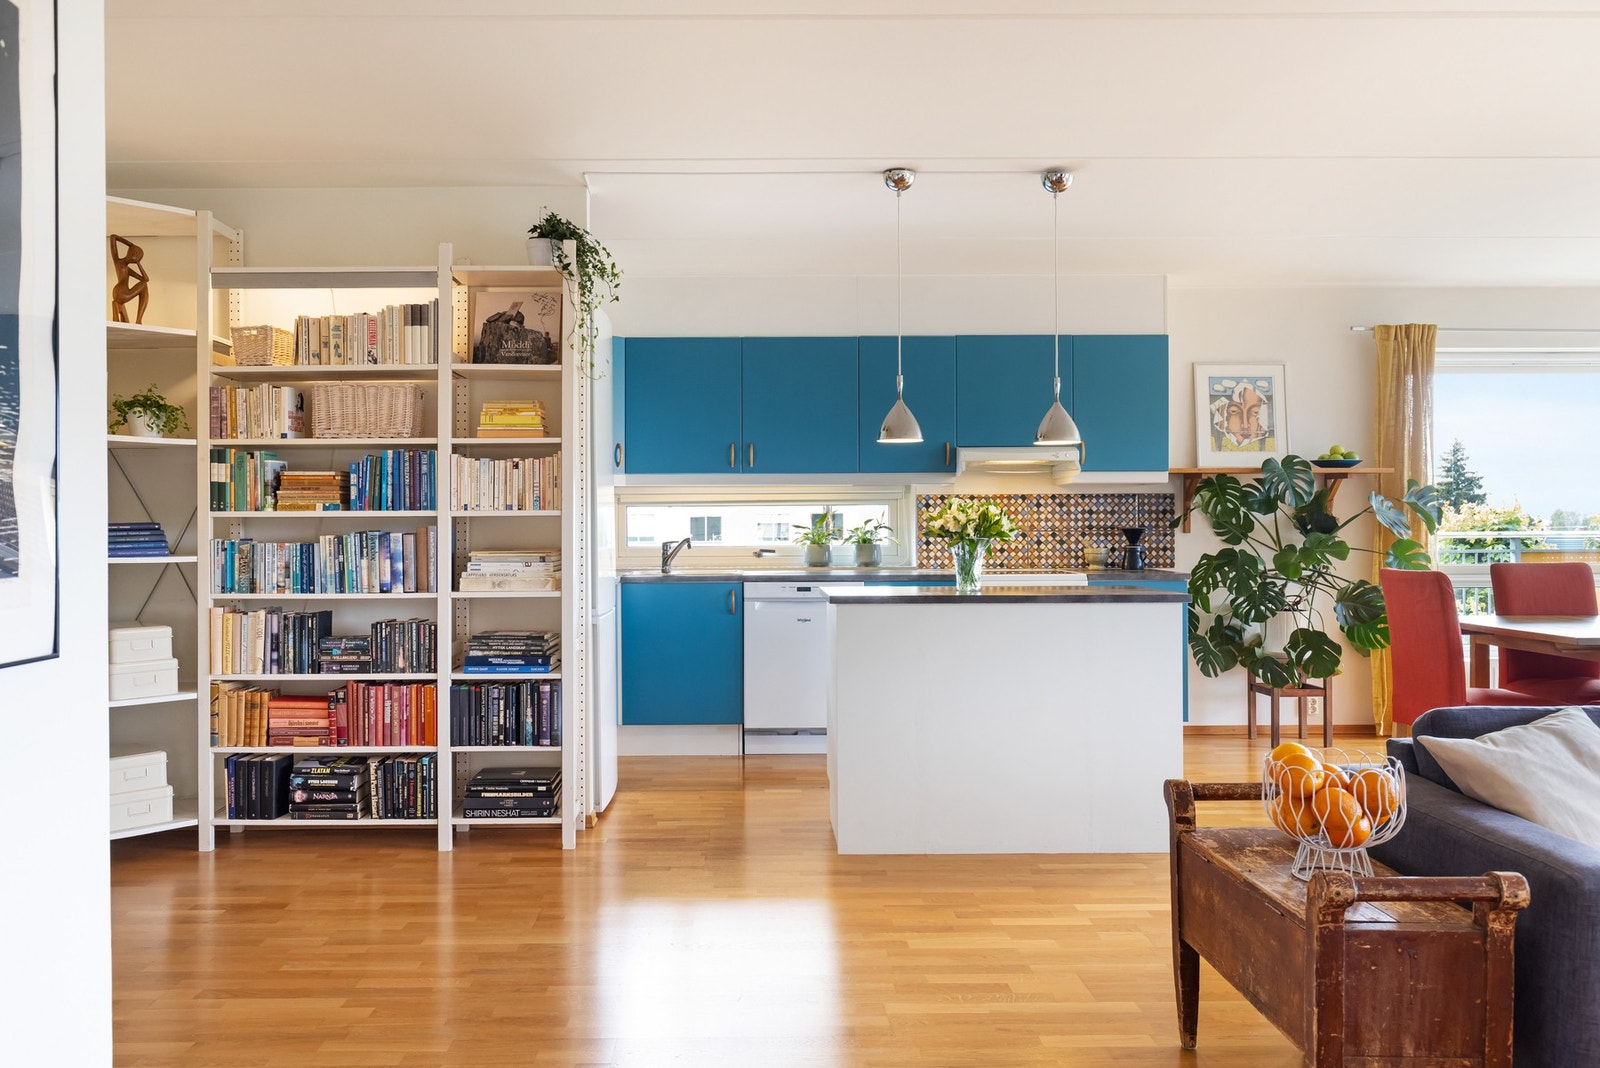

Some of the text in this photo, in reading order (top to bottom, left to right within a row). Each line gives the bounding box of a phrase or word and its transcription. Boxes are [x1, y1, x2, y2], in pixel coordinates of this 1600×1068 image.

[312, 792, 338, 800] NARNIA
[465, 809, 520, 817] SHIRIN NESHAT
